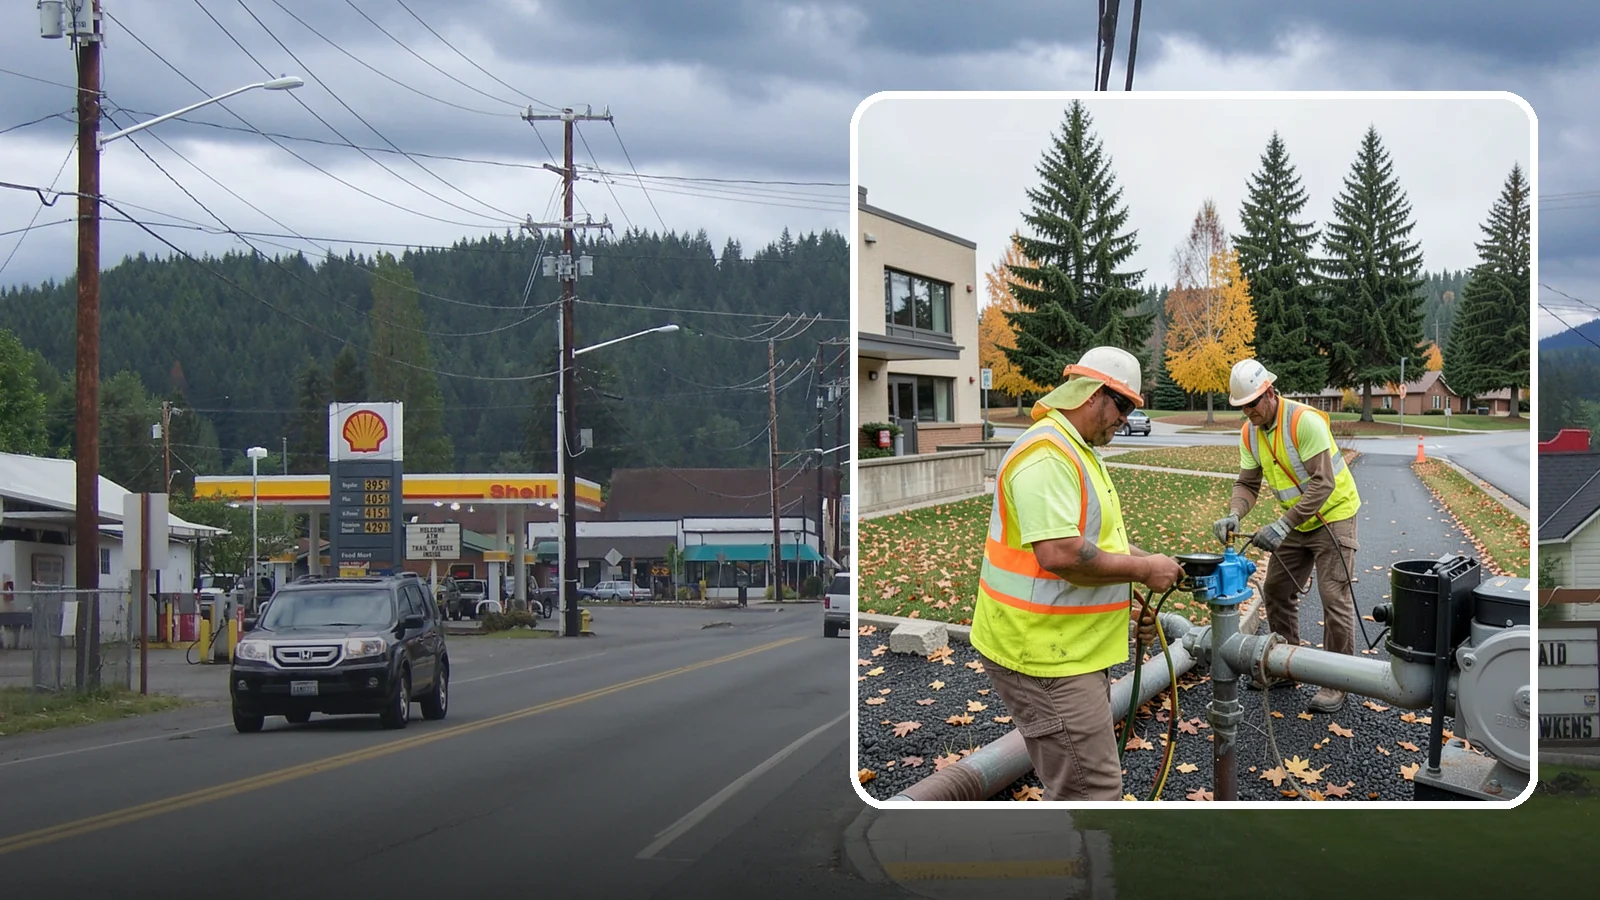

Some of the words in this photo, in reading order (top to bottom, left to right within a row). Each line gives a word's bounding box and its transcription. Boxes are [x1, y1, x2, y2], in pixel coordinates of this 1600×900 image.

[366, 480, 383, 490] 395
[490, 484, 547, 499] Shell
[366, 494, 383, 504] 405
[366, 508, 383, 518] 415
[366, 522, 383, 532] 429
[1539, 643, 1566, 665] AID
[1539, 716, 1592, 739] WKENS
